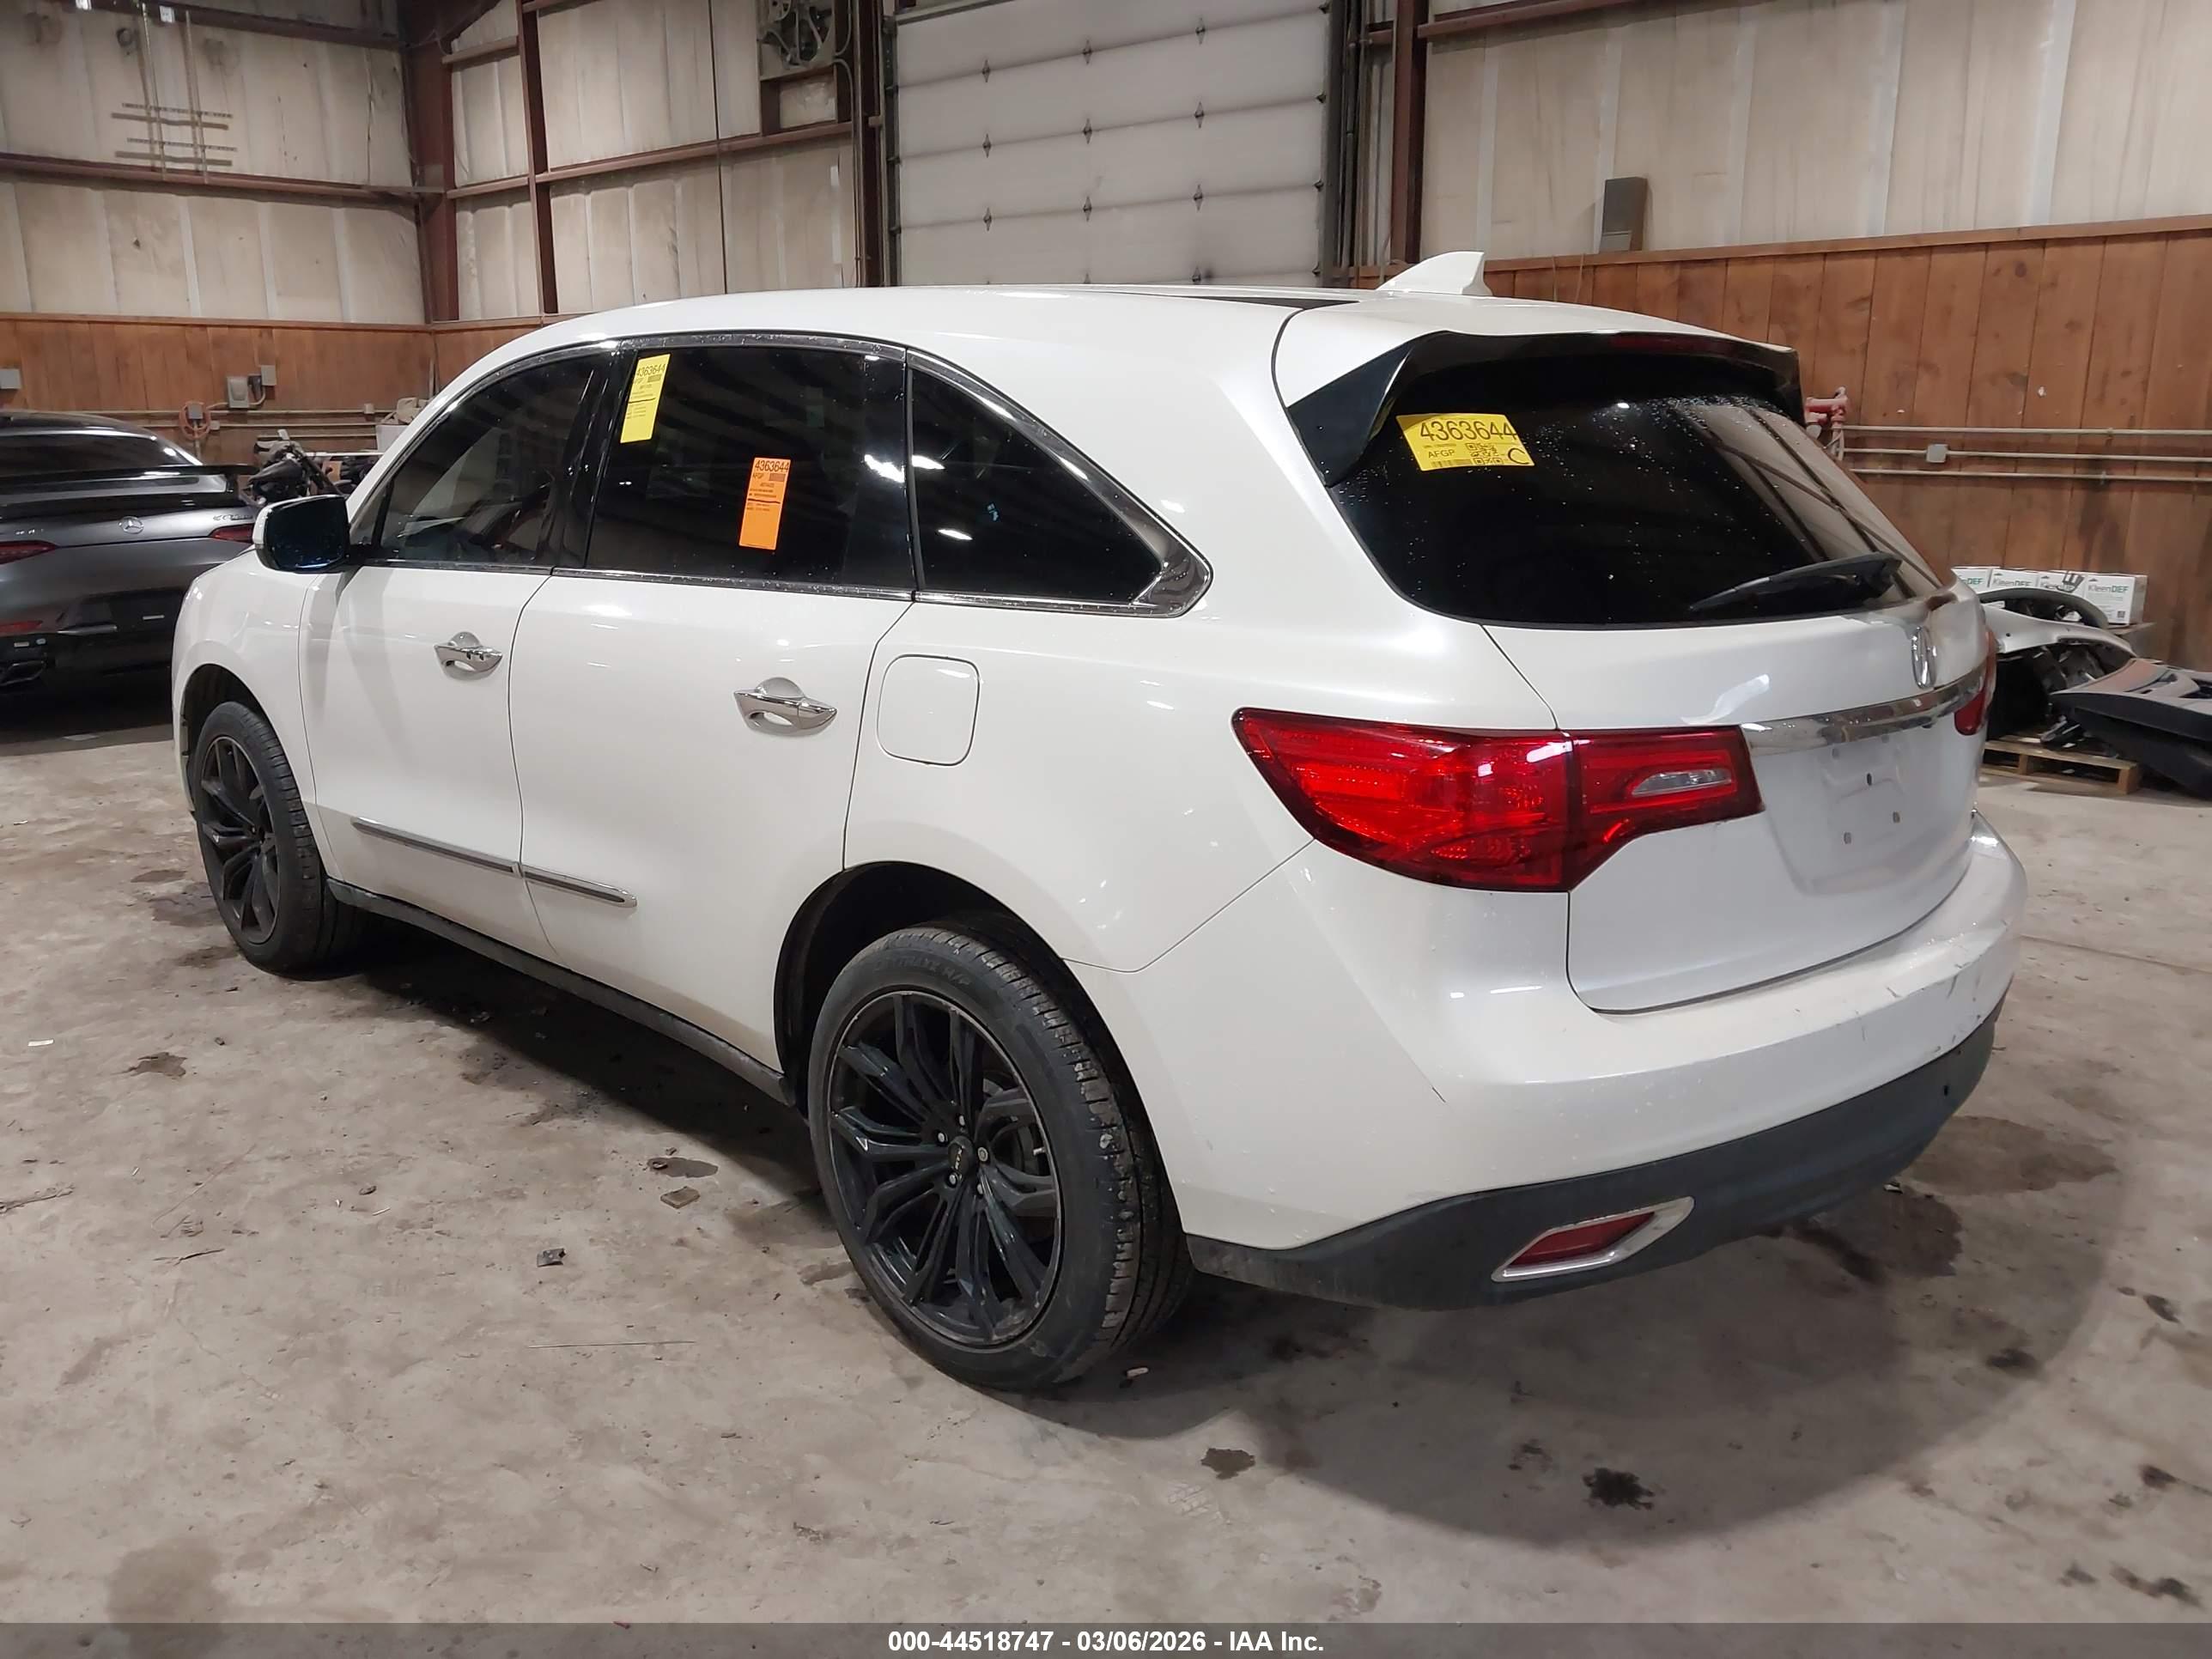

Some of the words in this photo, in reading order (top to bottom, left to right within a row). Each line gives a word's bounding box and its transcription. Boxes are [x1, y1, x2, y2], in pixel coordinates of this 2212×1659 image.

[636, 364, 665, 377] 4363644
[1420, 421, 1517, 441] 4363644
[1428, 449, 1455, 459] AFGP
[754, 460, 789, 472] 4363644
